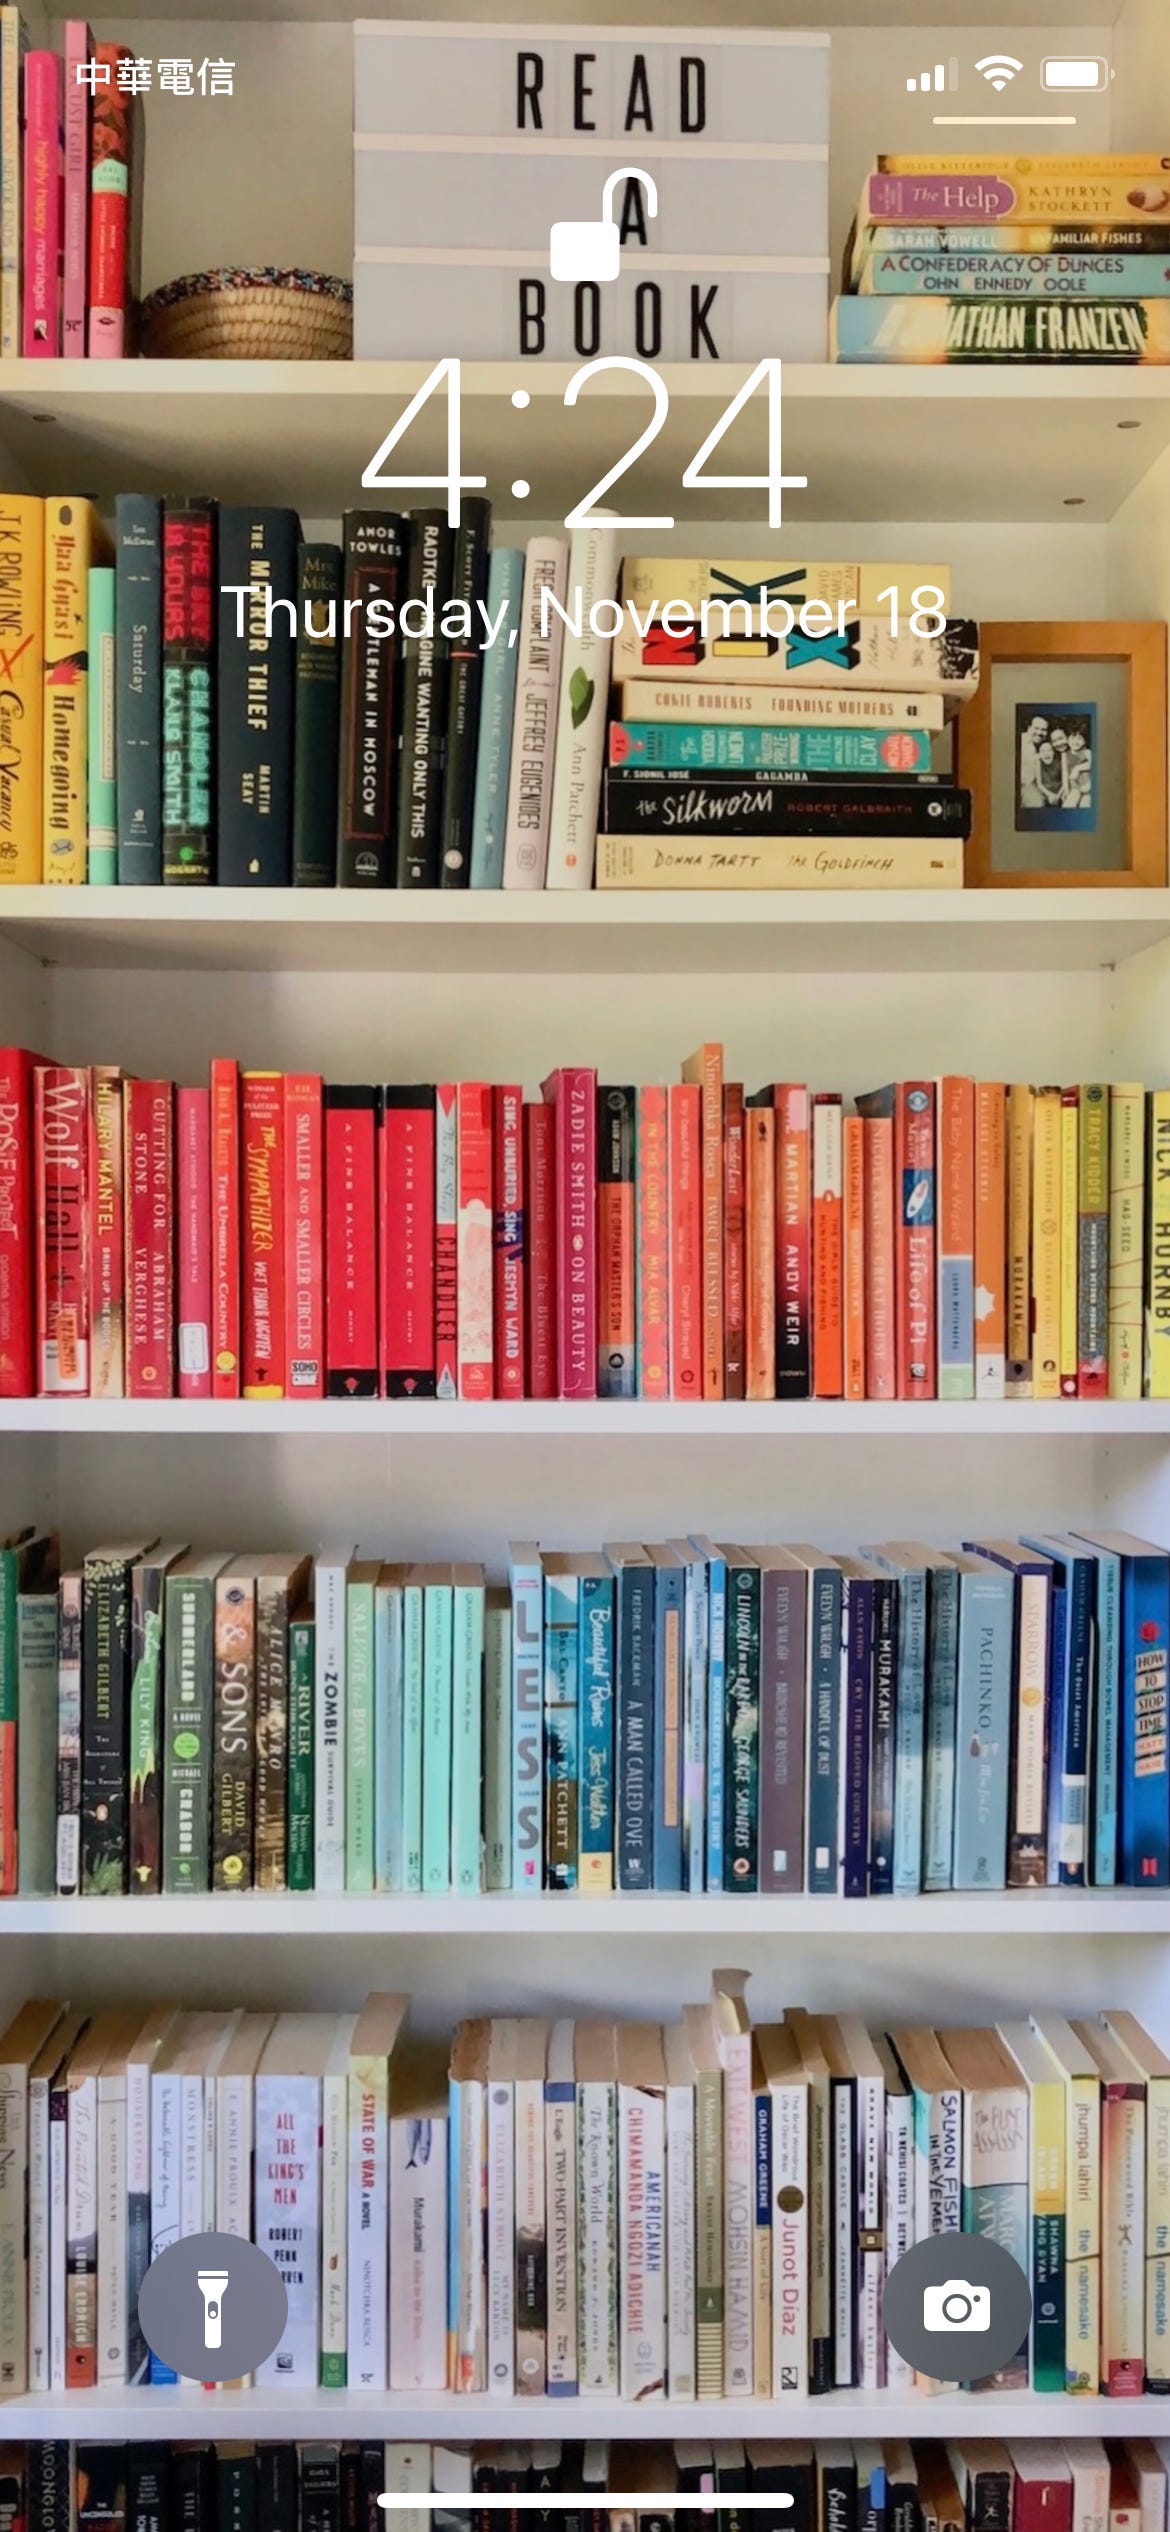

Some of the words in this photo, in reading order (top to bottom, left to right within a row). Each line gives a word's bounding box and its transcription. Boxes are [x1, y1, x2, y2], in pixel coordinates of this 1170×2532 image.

[517, 52, 706, 133] READ
[34, 141, 48, 185] highly
[33, 189, 48, 235] happy
[619, 176, 647, 245] A
[912, 187, 939, 202] The
[944, 186, 1000, 213] Help
[1028, 186, 1113, 197] KATHRYN
[1028, 201, 1111, 212] STOCKETT
[886, 232, 935, 248] SARAH
[939, 232, 998, 248] VOWELL
[34, 239, 48, 310] marriages
[881, 257, 895, 272] A
[899, 256, 1025, 274] CONFEDERACY
[1027, 257, 1052, 273] OF
[1058, 257, 1124, 274] DUNCES
[519, 279, 720, 358] BOOK
[1036, 307, 1146, 351] FRANZEN
[250, 524, 264, 549] THE
[349, 541, 402, 556] TOWLES
[357, 526, 396, 537] AMOR
[422, 525, 438, 589] RADTKE
[248, 560, 270, 651] MIRROR
[368, 583, 380, 594] A
[129, 624, 146, 693] Saturday
[165, 668, 181, 742] KLANG
[248, 664, 268, 731] THIEF
[366, 711, 378, 728] IN
[415, 682, 431, 756] WANTING
[523, 693, 547, 752] JEFFREY
[49, 695, 75, 830] Homegoing
[189, 668, 209, 826] CHANDLER
[569, 742, 587, 777] Ann
[165, 750, 182, 825] SMITH
[242, 773, 254, 804] SEAY
[257, 765, 270, 813] MARTIN
[362, 738, 377, 817] MOSCOW
[412, 760, 428, 799] ONLY
[517, 760, 543, 830] EUGENIDES
[411, 803, 425, 839] THIS
[565, 780, 585, 844] Patchett
[43, 1080, 81, 1169] Wolf
[97, 1082, 113, 1152] HILARY
[260, 1125, 277, 1148] THE
[344, 1123, 353, 1132] A
[406, 1123, 414, 1132] A
[570, 1090, 585, 1155] ZADIE
[1087, 1109, 1102, 1152] TRACY
[134, 1132, 148, 1195] STONE
[153, 1098, 166, 1185] CUTTING
[296, 1113, 311, 1181] SMALLER
[1156, 1118, 1170, 1182] NICK
[218, 1173, 229, 1203] THE
[344, 1145, 353, 1191] FINE
[406, 1145, 414, 1191] FINE
[785, 1144, 800, 1226] MARTIAN
[1087, 1156, 1102, 1205] KIDDER
[45, 1184, 80, 1252] Hall
[97, 1159, 114, 1236] MANTEL
[153, 1193, 166, 1230] FOR
[246, 1143, 272, 1253] SYMPATHIZER
[299, 1186, 310, 1214] AND
[570, 1161, 585, 1228] SMITH
[101, 1247, 111, 1278] BRING
[218, 1206, 229, 1279] UMBRELLA
[297, 1218, 312, 1284] SMALLER
[345, 1202, 354, 1290] BALANCE
[406, 1202, 414, 1290] BALANCE
[909, 1235, 927, 1283] Life
[102, 1280, 111, 1294] UP
[436, 1237, 456, 1343] CHANDLER
[503, 1257, 517, 1311] JESMYN
[570, 1257, 585, 1283] ON
[785, 1244, 800, 1293] ANDY
[1154, 1222, 1170, 1338] HORNBY
[102, 1296, 111, 1313] THE
[134, 1247, 148, 1345] VERGHESE
[153, 1251, 165, 1340] ABRAHAM
[218, 1282, 229, 1350] COUNTRY
[909, 1287, 926, 1309] of
[297, 1290, 313, 1350] CIRCLES
[505, 1318, 518, 1359] WARD
[571, 1293, 586, 1372] BEAUTY
[786, 1300, 800, 1346] WEIR
[910, 1321, 927, 1343] Pi
[95, 1583, 110, 1657] ELIZABETH
[221, 1623, 249, 1646] &
[587, 1605, 611, 1676] Beautiful
[877, 1639, 892, 1729] MURAKAMI
[978, 1627, 994, 1729] PACHINKO
[1138, 1653, 1164, 1668] HOW
[1145, 1675, 1157, 1686] TO
[96, 1663, 110, 1720] GILBERT
[138, 1677, 152, 1714] LILY
[220, 1663, 248, 1754] SONS
[323, 1672, 338, 1747] ZOMBIE
[590, 1679, 611, 1727] Ruins
[627, 1700, 644, 1711] A
[1139, 1695, 1164, 1711] STOP
[138, 1718, 152, 1759] KING
[298, 1684, 311, 1757] RIVER
[556, 1718, 568, 1755] ANN
[626, 1717, 644, 1752] MAN
[1139, 1717, 1163, 1732] TIME
[326, 1752, 335, 1795] SURVIVAL
[735, 1736, 752, 1783] GEORGE
[220, 1773, 232, 1836] GILBERT
[233, 1781, 246, 1828] DAVID
[556, 1761, 569, 1850] PATCHETT
[626, 1757, 644, 1811] CALLED
[326, 1799, 335, 1827] GUIDE
[626, 1817, 644, 1848] OVE
[736, 1789, 751, 1848] SAUNDERS
[705, 2084, 716, 2093] A
[277, 2113, 294, 2130] ALL
[362, 2093, 375, 2133] STATE
[704, 2097, 716, 2155] Moveable
[758, 2109, 768, 2161] GRAHAM
[942, 2096, 957, 2169] SALMON
[1075, 2103, 1092, 2160] jhumpa
[277, 2138, 295, 2156] THE
[362, 2137, 375, 2155] OF
[628, 2107, 642, 2213] CHIMAMANDA
[268, 2163, 304, 2181] KING'S
[274, 2187, 297, 2205] MEN
[362, 2159, 375, 2189] WAR
[704, 2158, 716, 2187] Feast
[758, 2164, 768, 2209] GREENE
[1077, 2164, 1093, 2202] lahiri
[268, 2228, 303, 2241] ROBERT
[412, 2197, 425, 2253] Murakami
[628, 2220, 643, 2267] NGOZI
[646, 2171, 661, 2272] AMERICANAH
[1078, 2229, 1092, 2252] the
[273, 2250, 297, 2262] PENN
[781, 2219, 798, 2280] Junot
[1049, 2219, 1059, 2274] SHAWNA
[628, 2274, 643, 2334] ADICHIE
[782, 2288, 800, 2336] Díaz
[1078, 2265, 1092, 2340] namesake
